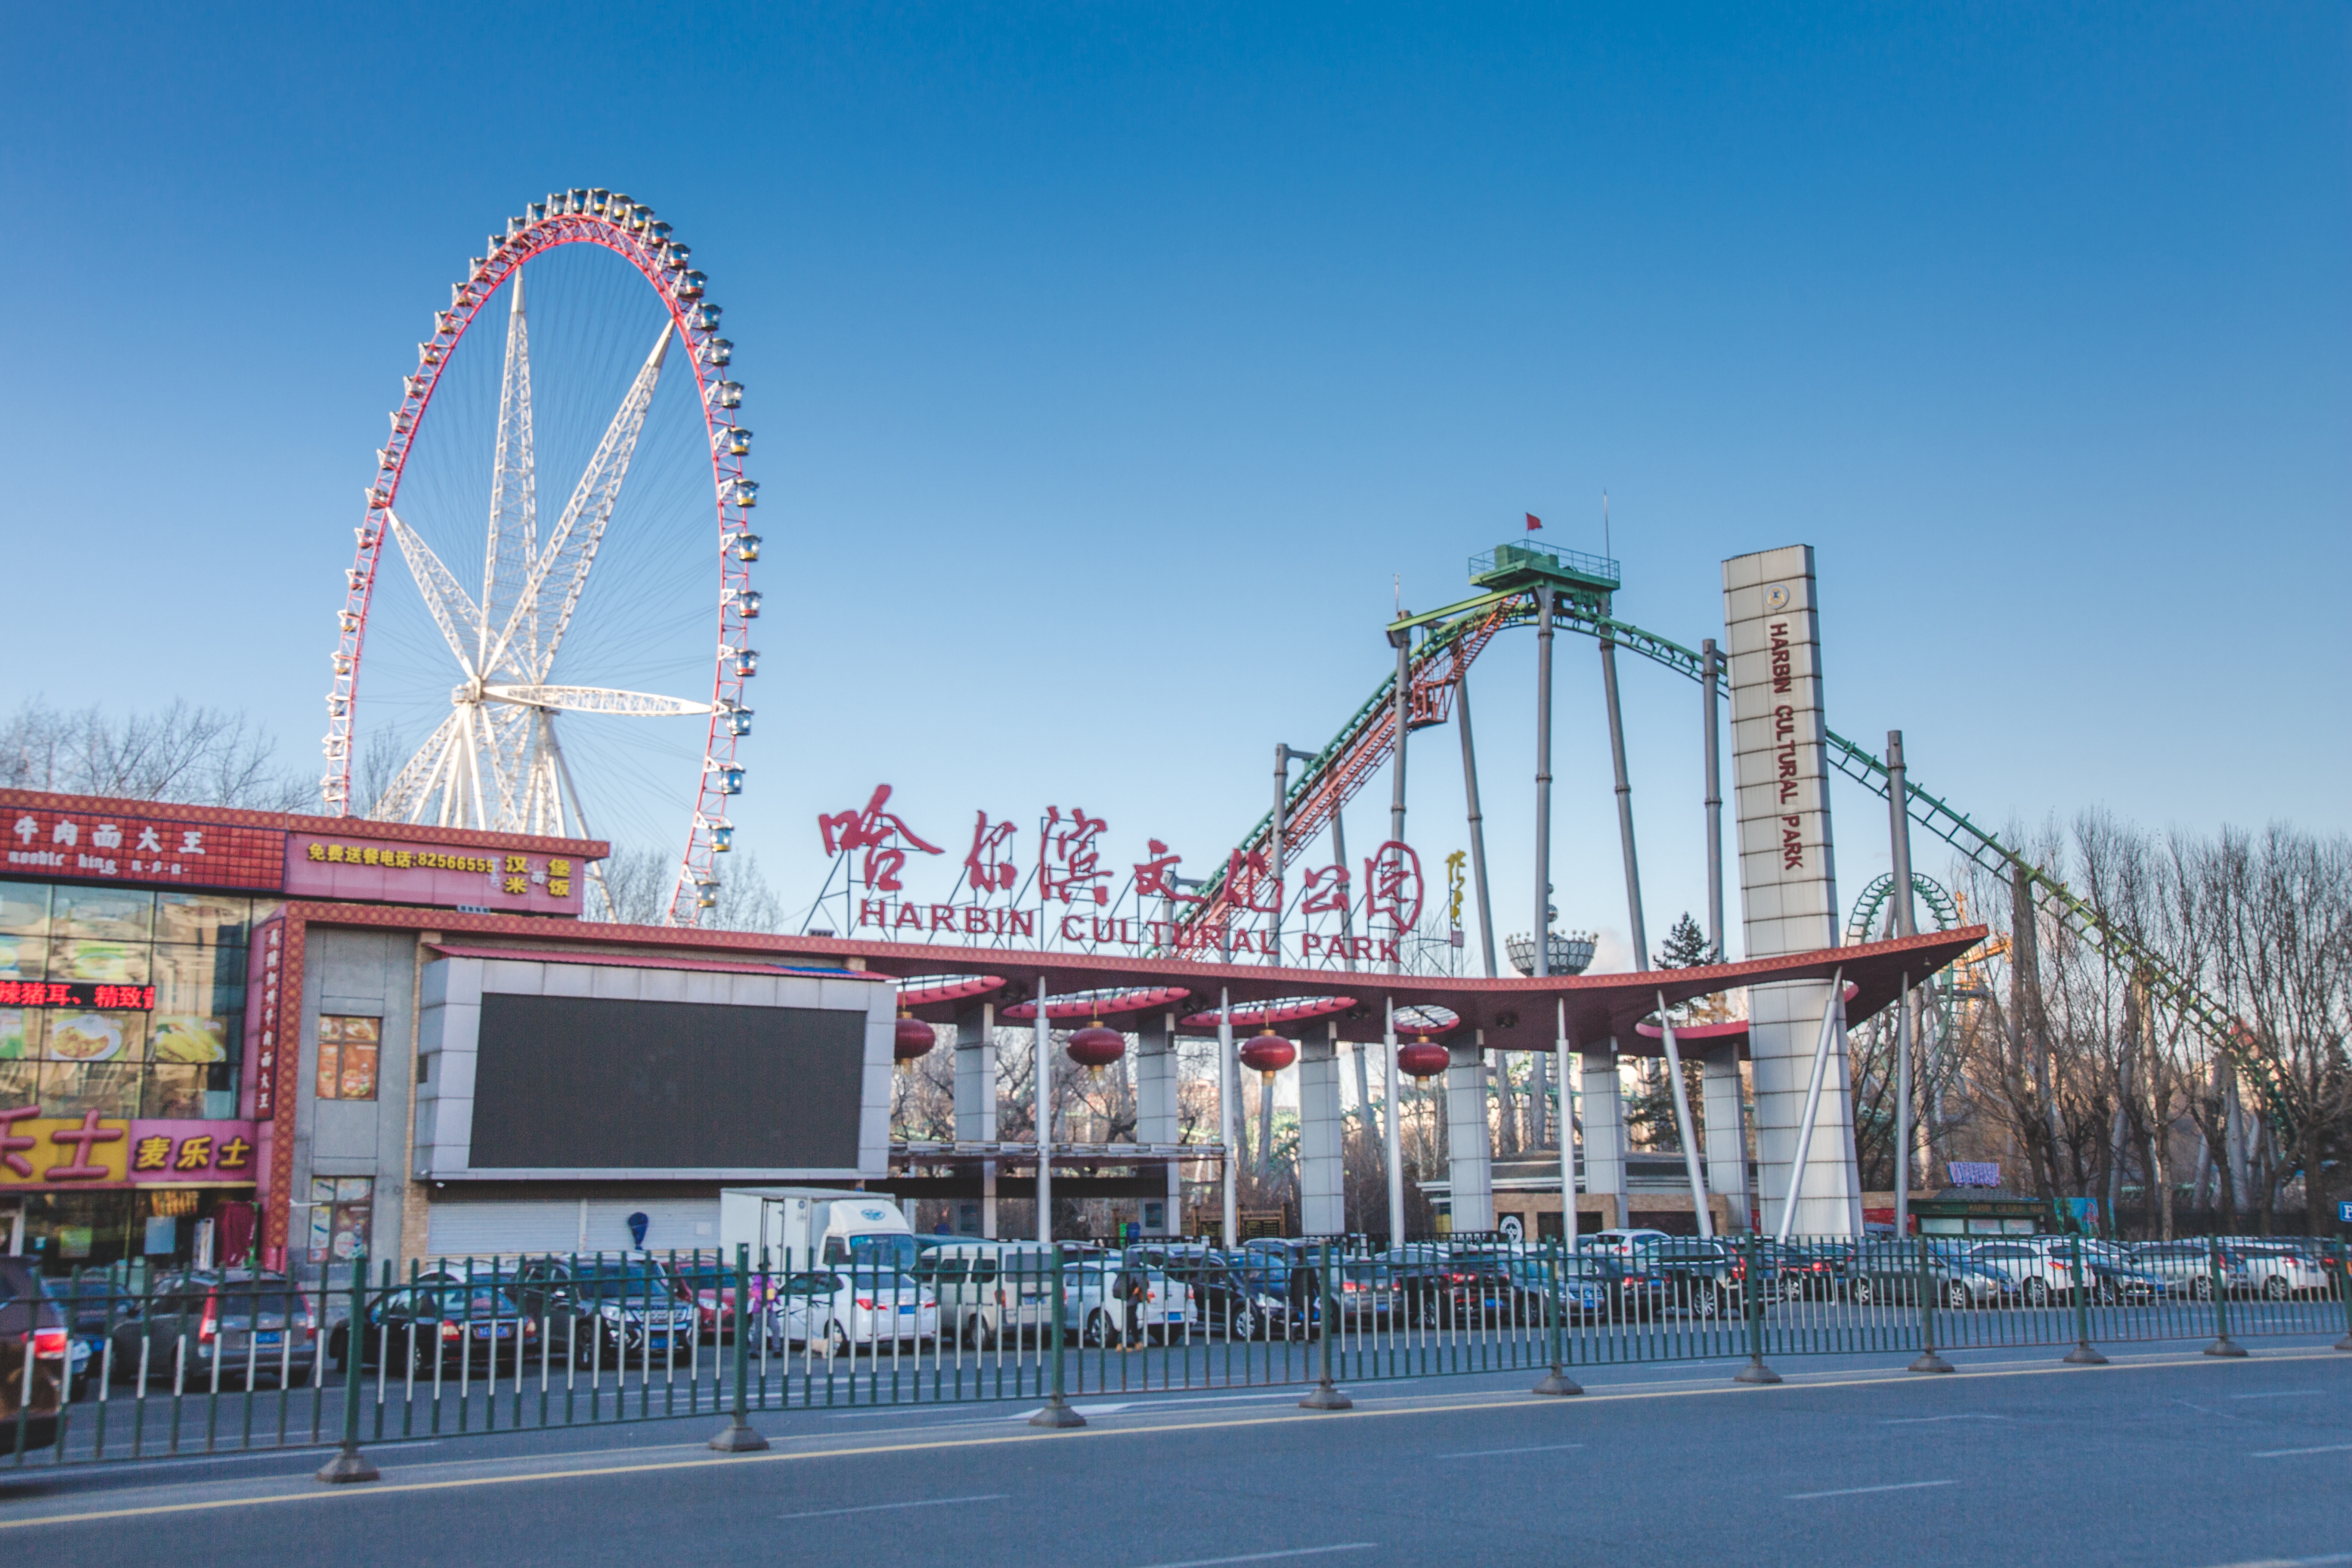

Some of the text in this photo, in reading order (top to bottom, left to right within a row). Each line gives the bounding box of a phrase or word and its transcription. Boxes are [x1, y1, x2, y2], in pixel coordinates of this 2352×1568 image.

[1770, 623, 1804, 871] HARBIN CULTURAL PARK
[13, 815, 206, 855] 牛肉面大王
[505, 854, 571, 877] 汉堡
[504, 876, 570, 897] 米饭
[860, 899, 1401, 963] HARBIN CULTURAL PARK
[135, 1136, 250, 1168] 麦乐士
